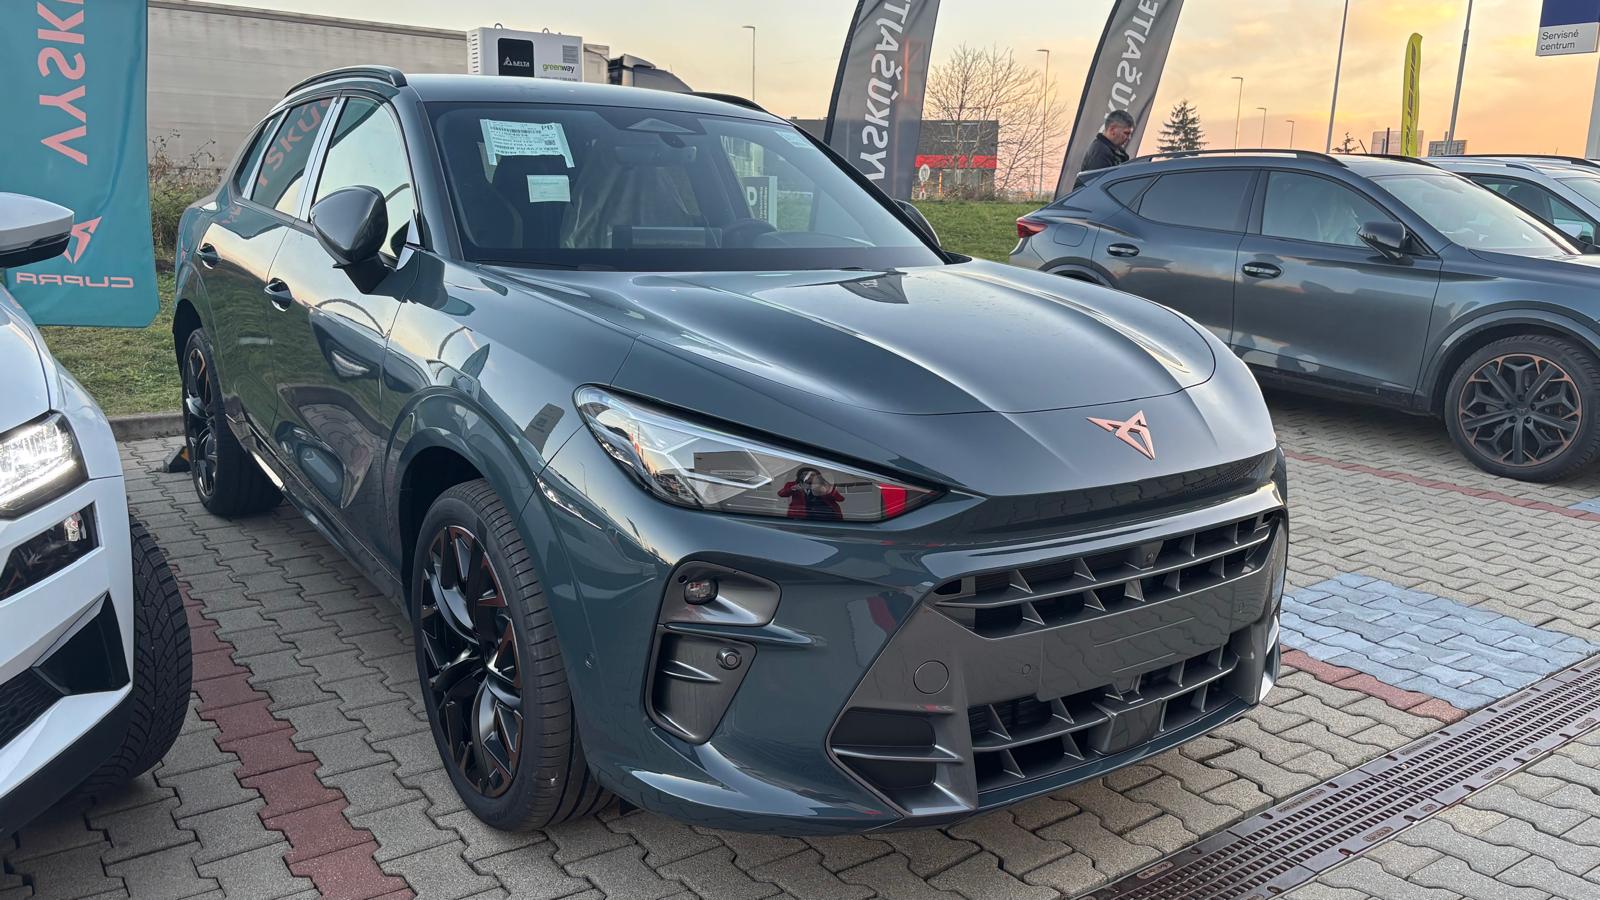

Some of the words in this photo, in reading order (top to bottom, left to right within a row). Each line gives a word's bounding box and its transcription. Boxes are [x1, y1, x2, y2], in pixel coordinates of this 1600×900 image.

[1541, 29, 1579, 41] Servisné
[1540, 41, 1576, 51] centrum
[542, 63, 575, 73] greenway
